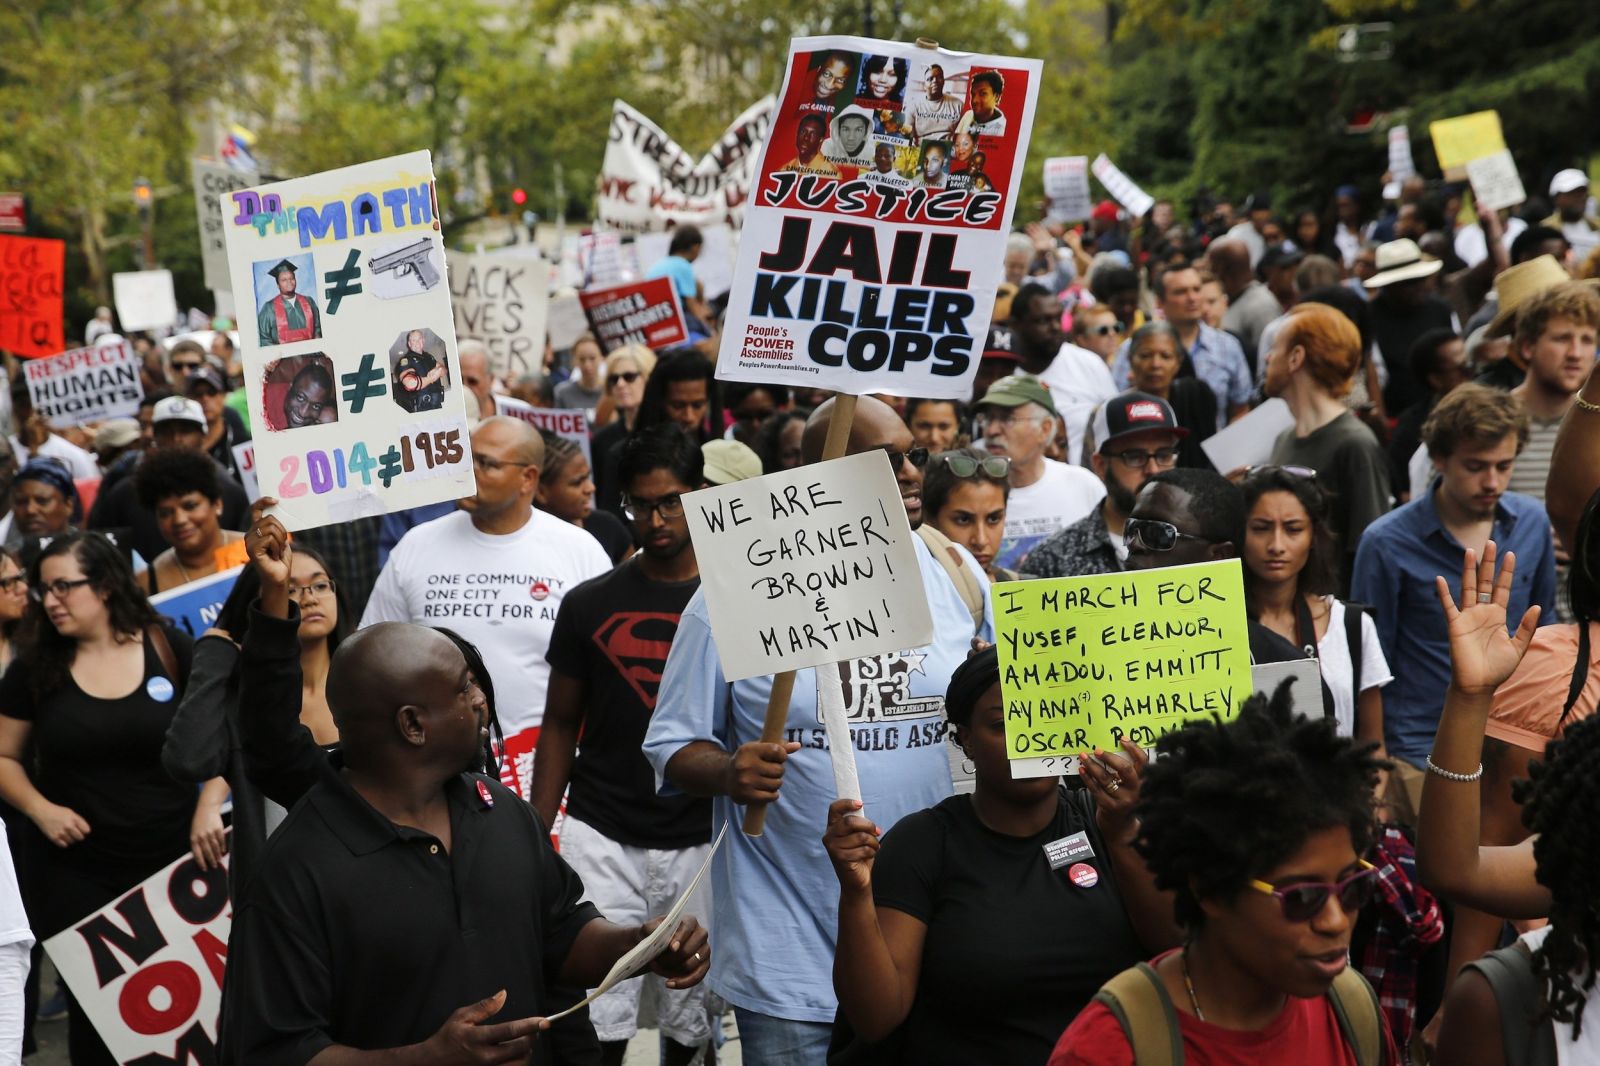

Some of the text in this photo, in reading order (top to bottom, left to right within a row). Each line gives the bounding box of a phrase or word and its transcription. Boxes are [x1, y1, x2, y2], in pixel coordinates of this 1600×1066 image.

[811, 103, 835, 113] GARNER
[815, 168, 838, 177] GRAHAM
[823, 155, 871, 167] TRAYVON MARTIN
[864, 173, 879, 182] ALAN
[880, 174, 910, 187] BLUEFORD
[252, 206, 297, 237] THE
[297, 178, 439, 248] MATH!
[764, 172, 1001, 224] JUSTICE
[759, 215, 971, 290] JAIL
[448, 264, 526, 299] LACK
[750, 271, 975, 336] KILLER
[744, 337, 794, 350] POWER
[746, 324, 788, 337] People's
[808, 322, 974, 377] COPS
[28, 342, 125, 380] RESPECT
[740, 347, 793, 361] Assemblies
[35, 363, 135, 402] HUMAN
[278, 441, 377, 498] 2014
[400, 429, 463, 473] 1955
[701, 483, 842, 533] WE ARE
[747, 498, 896, 566] GARNER!
[425, 589, 501, 600] ONE CITY
[427, 573, 565, 589] ONE COMMUNITY
[752, 553, 896, 599] BROWN!
[424, 603, 558, 621] RESPECT FOR AL
[999, 577, 1226, 614] I MARCH FOR
[759, 599, 895, 657] MARTIN!
[1002, 617, 1222, 661] YUSEF, ELEANOR,
[1005, 647, 1233, 690] AMADOU, EMMITT,
[884, 703, 925, 716] ESTABLISHED
[1015, 728, 1096, 753] OSCAR,
[74, 859, 230, 990] NO
